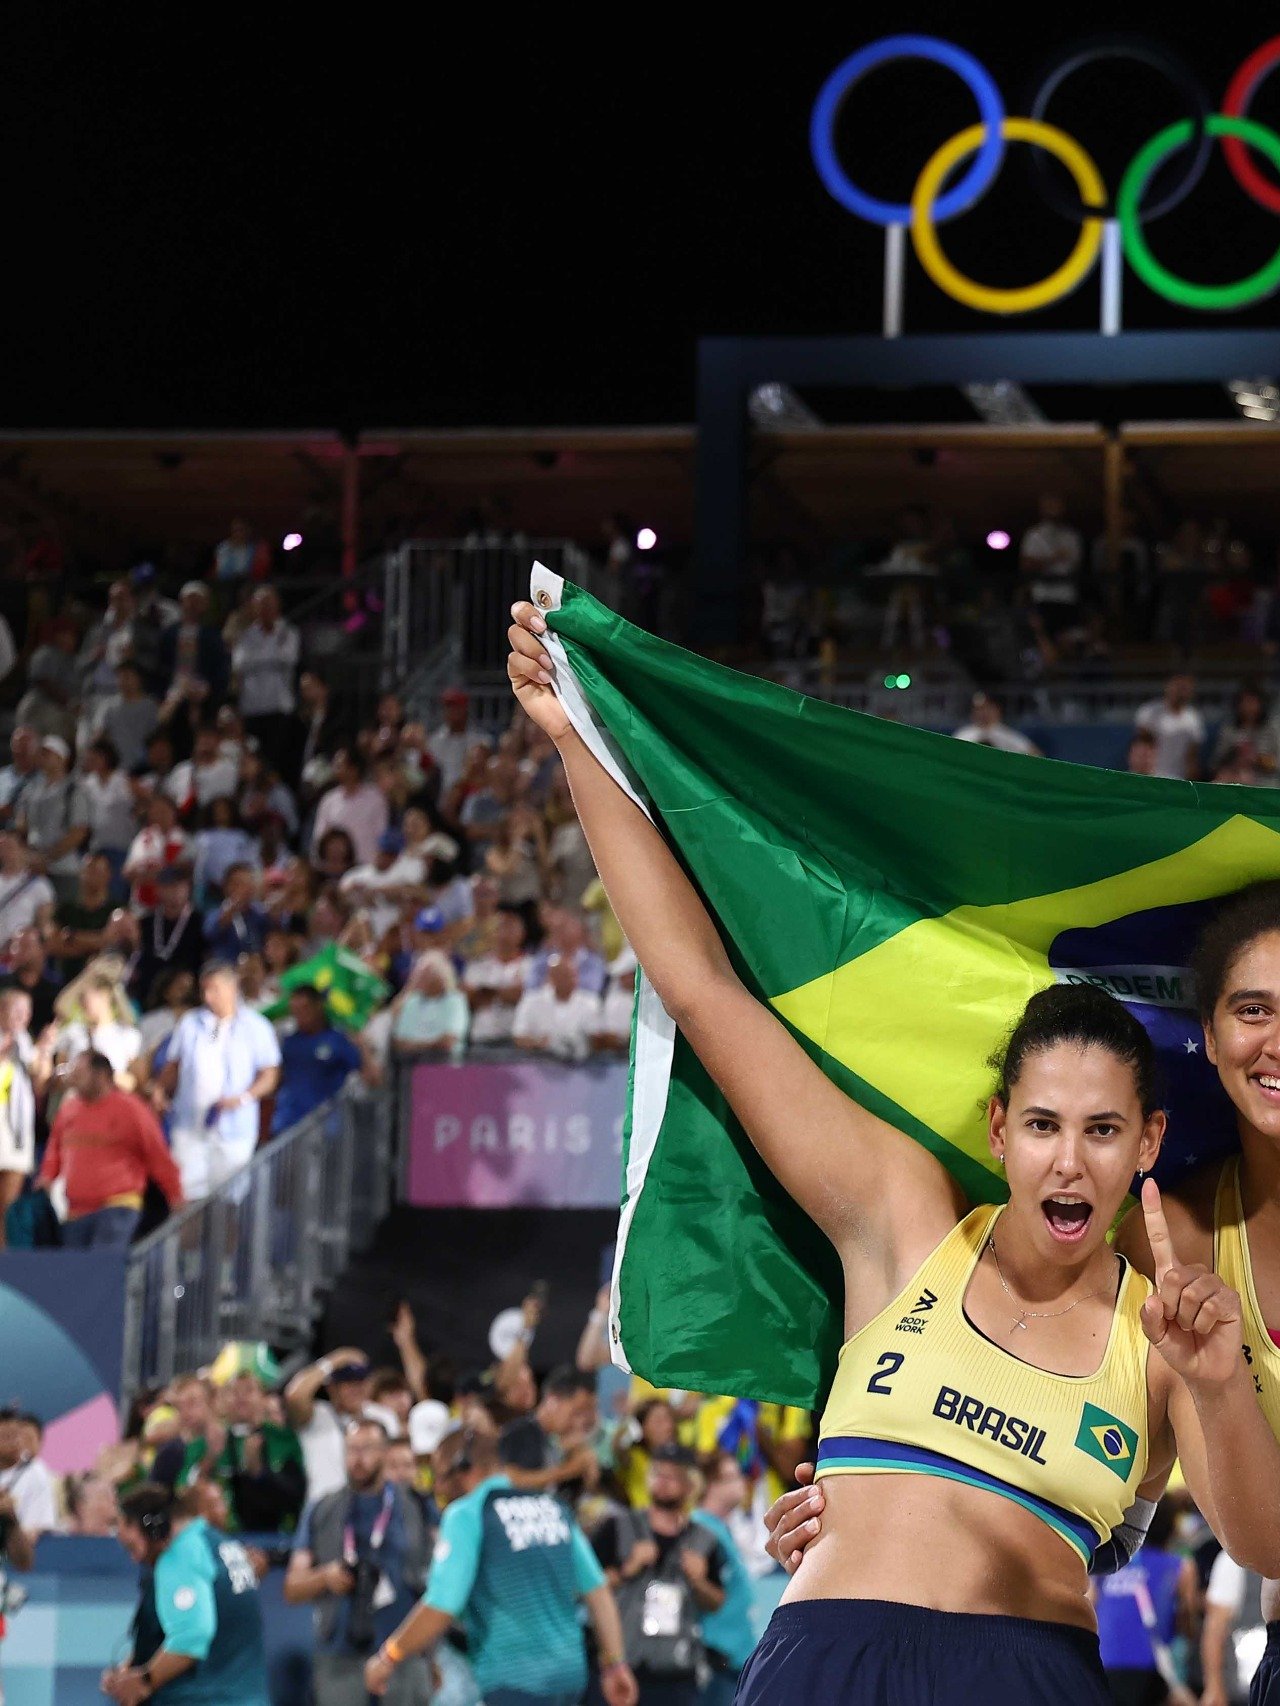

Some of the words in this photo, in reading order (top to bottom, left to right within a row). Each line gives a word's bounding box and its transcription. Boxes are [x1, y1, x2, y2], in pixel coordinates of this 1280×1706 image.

[433, 1113, 592, 1154] PARIS
[895, 1324, 925, 1334] WORK
[900, 1317, 929, 1327] BODY
[867, 1352, 905, 1395] 2
[932, 1385, 1047, 1466] BRASIL
